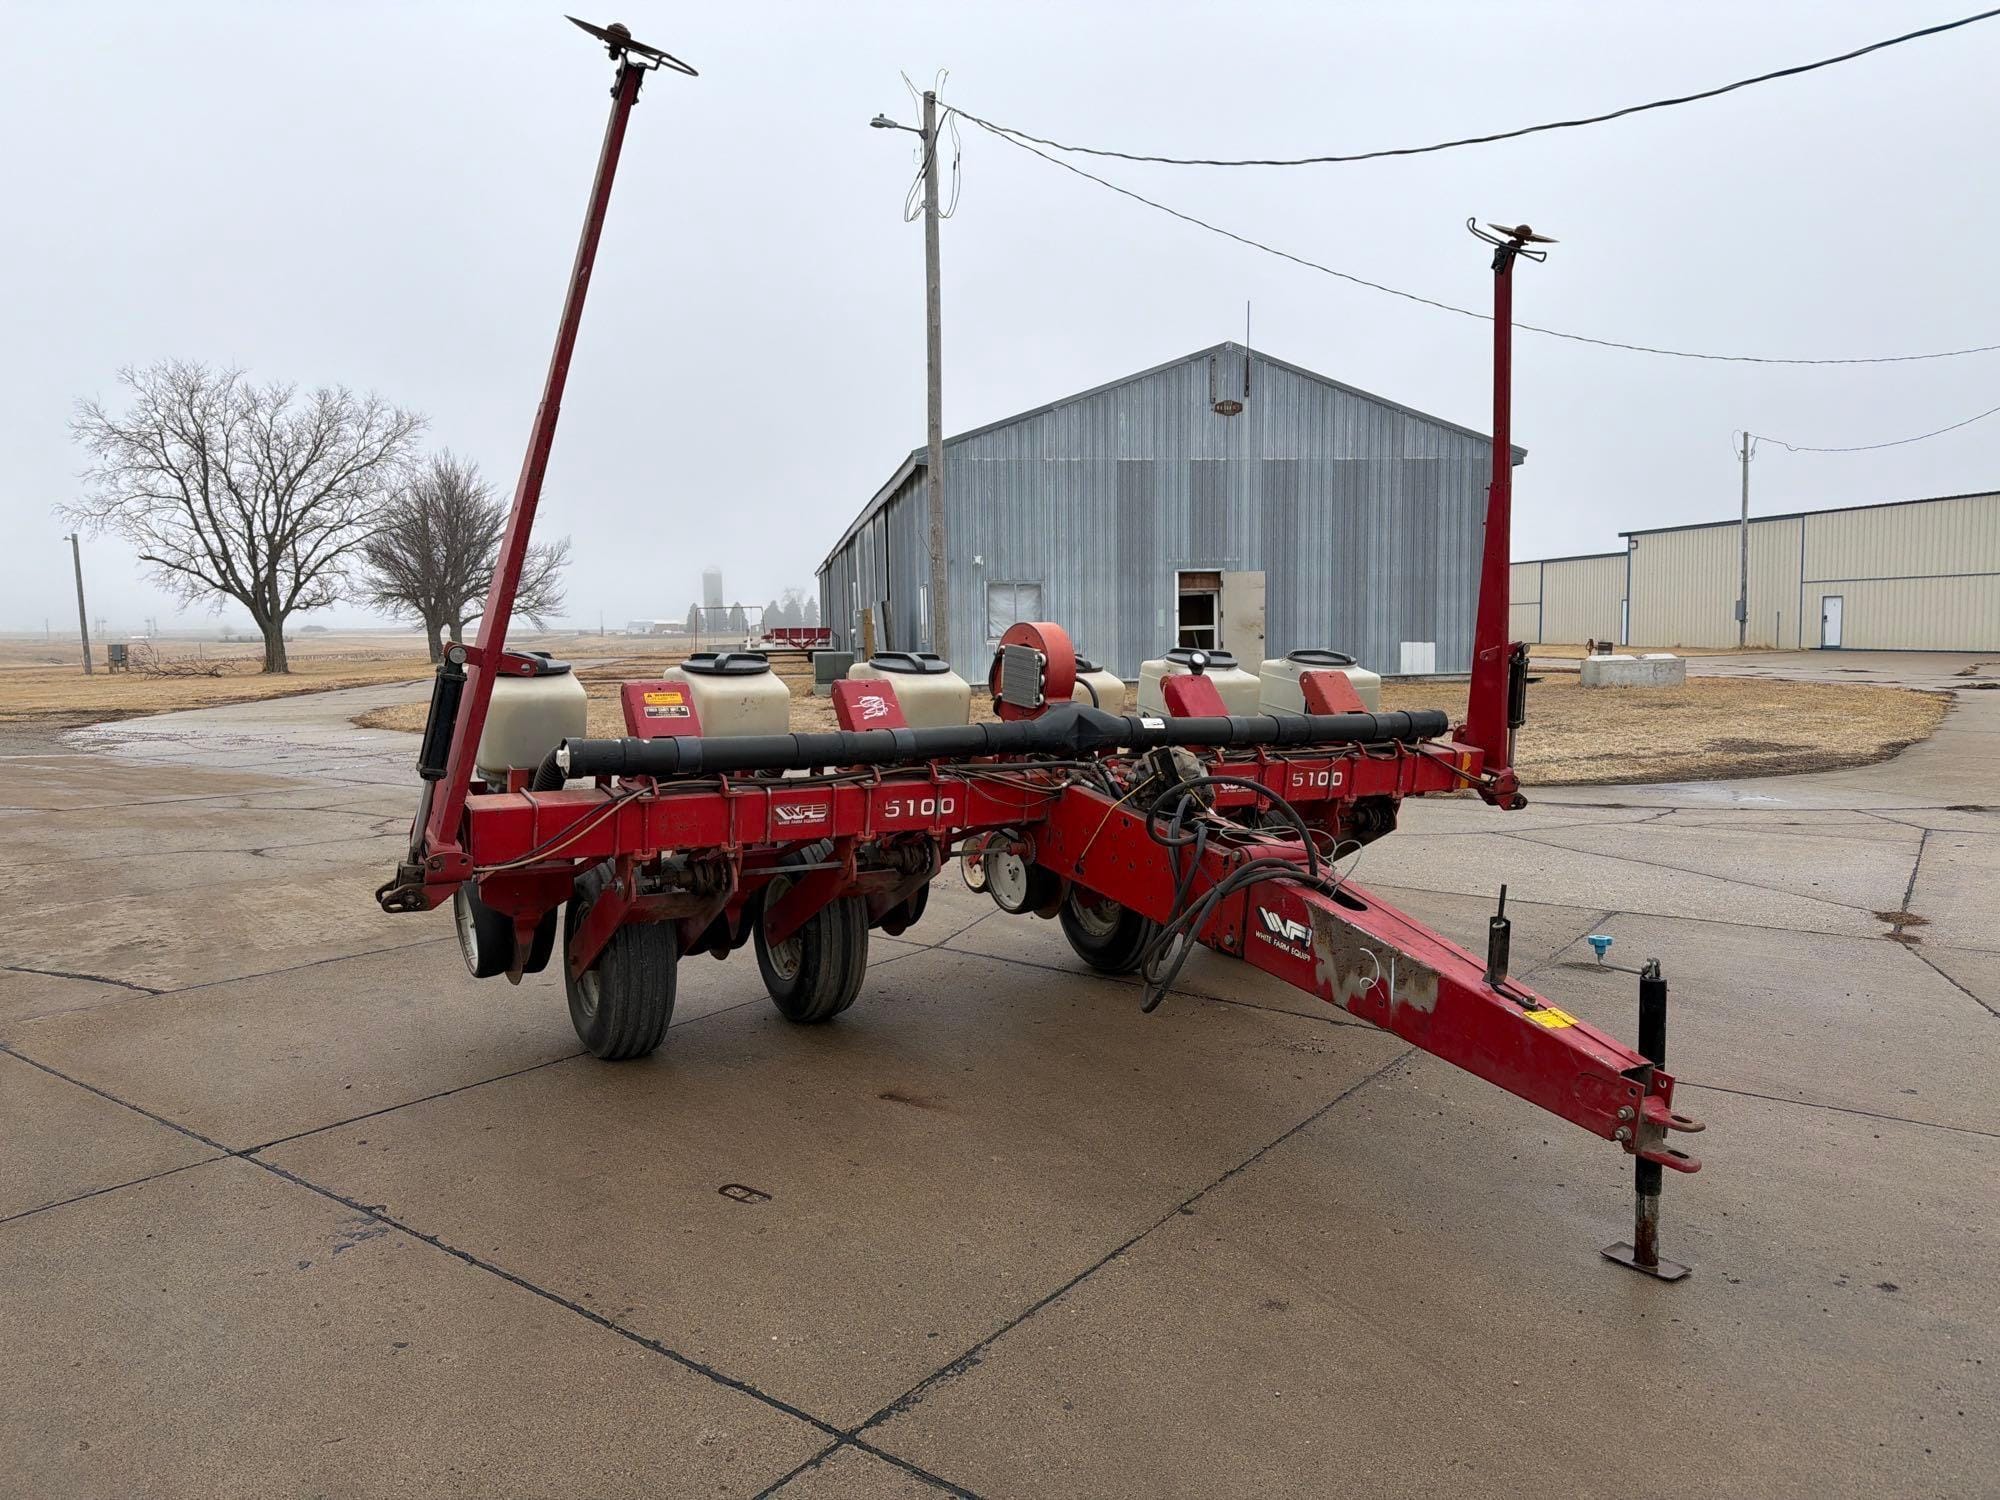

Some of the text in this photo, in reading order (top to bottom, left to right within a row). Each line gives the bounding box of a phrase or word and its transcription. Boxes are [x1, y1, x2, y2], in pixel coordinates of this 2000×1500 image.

[1292, 771, 1343, 787] 5100
[884, 797, 955, 818] 5100
[1255, 929, 1272, 946] WHITE
[1273, 938, 1290, 953] FARM
